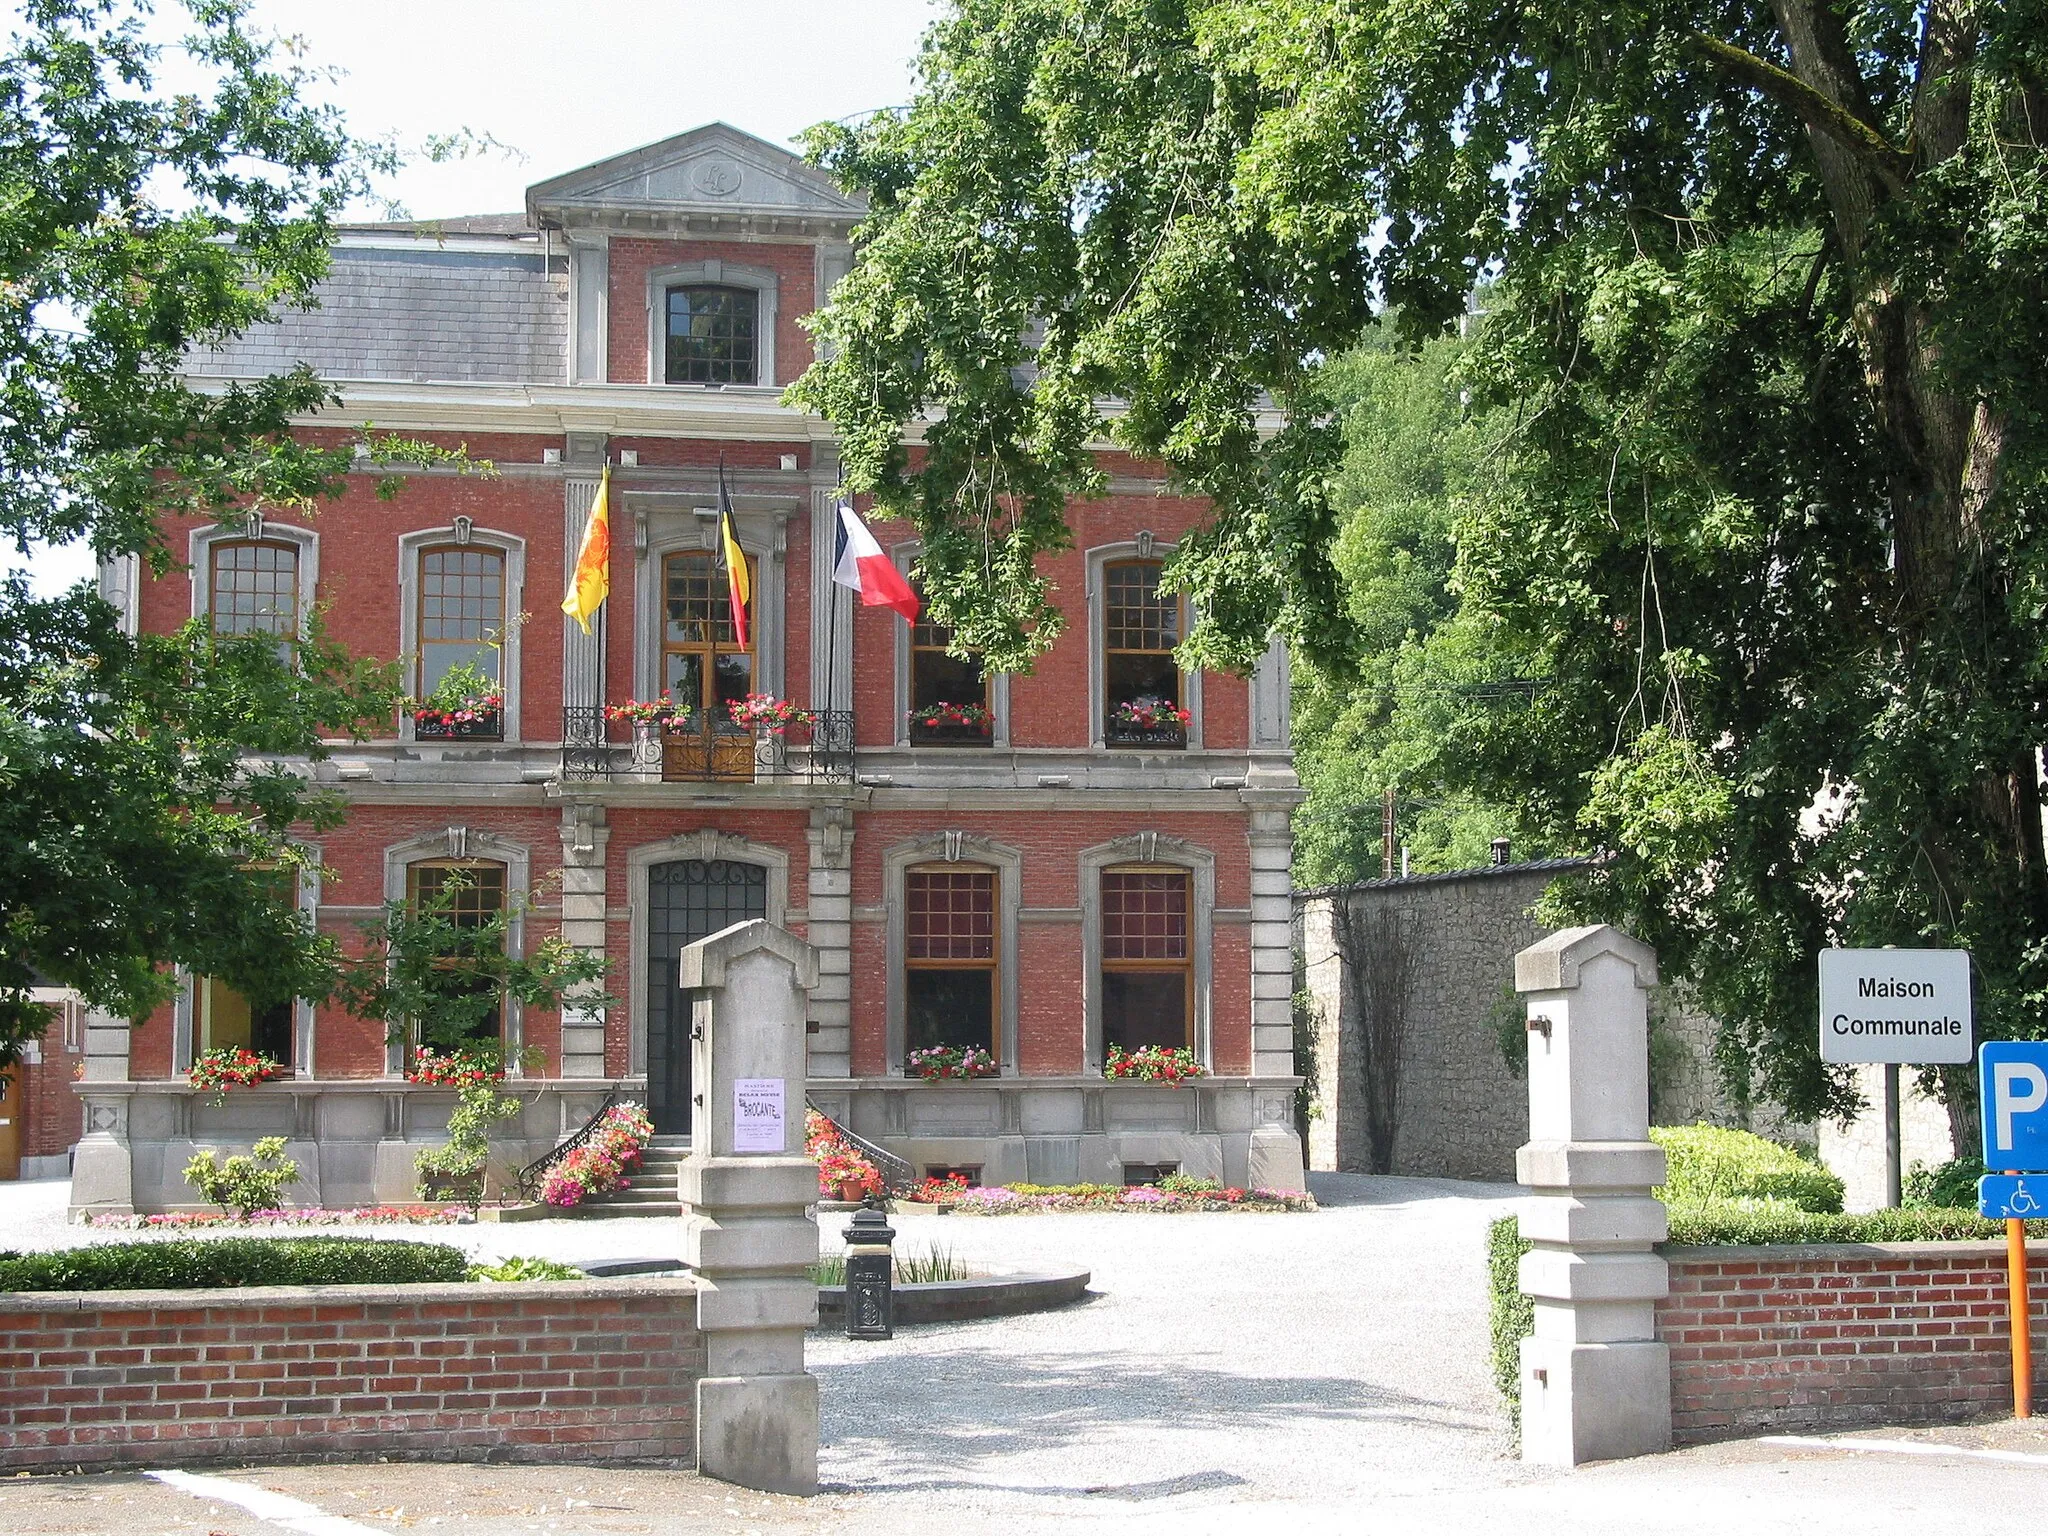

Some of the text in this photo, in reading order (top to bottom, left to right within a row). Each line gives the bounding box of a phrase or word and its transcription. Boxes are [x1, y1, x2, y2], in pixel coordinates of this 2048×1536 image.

[1858, 977, 1934, 998] Maison
[1832, 1014, 1962, 1036] Communale
[744, 1102, 776, 1117] BROCANTE
[1993, 1062, 2047, 1151] P
